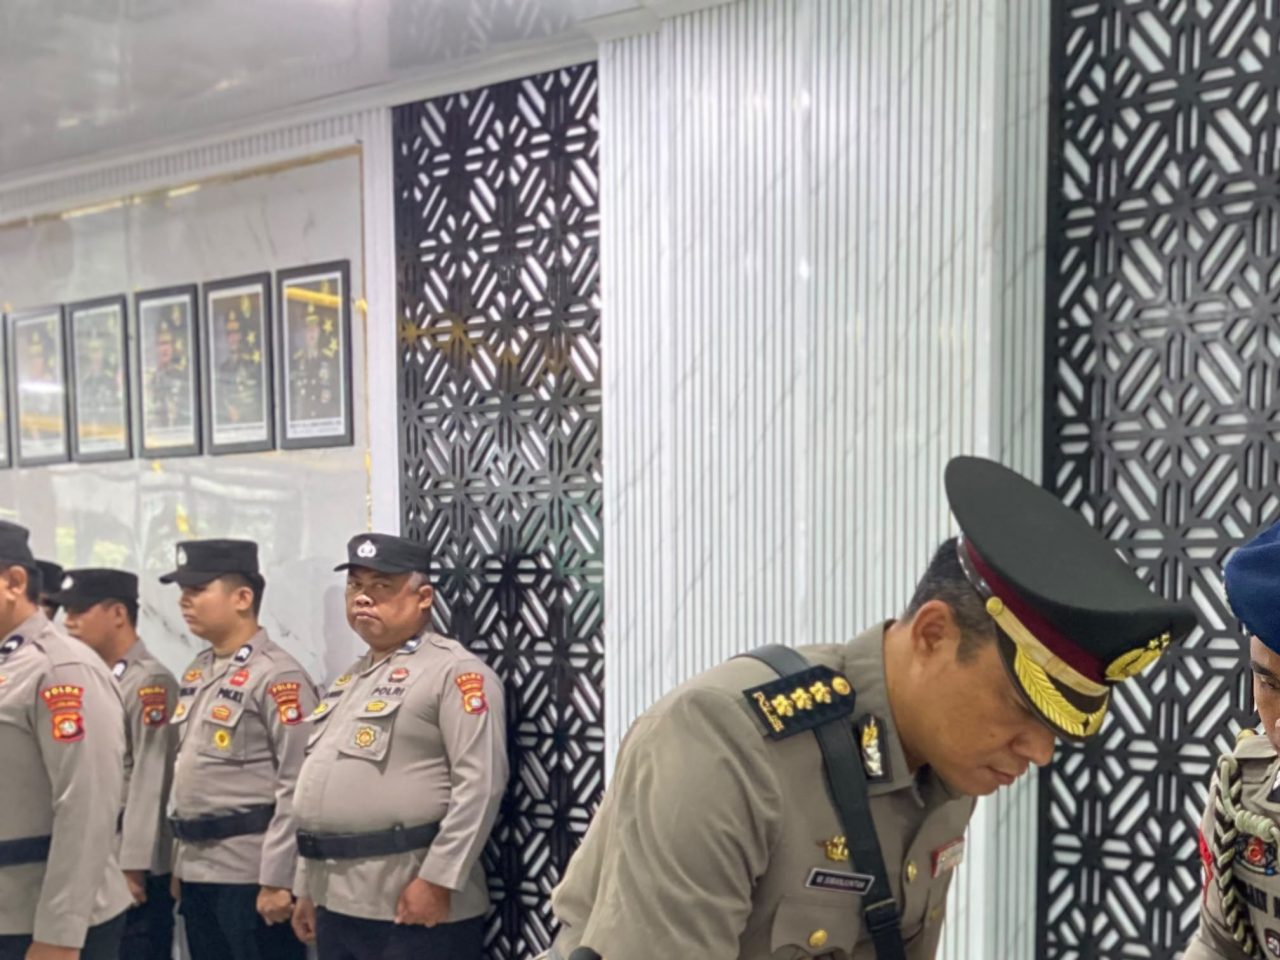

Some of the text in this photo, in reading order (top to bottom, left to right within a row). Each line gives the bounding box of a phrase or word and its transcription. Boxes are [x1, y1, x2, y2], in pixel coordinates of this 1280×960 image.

[44, 686, 79, 699] POLDA
[217, 688, 243, 703] POLRI
[371, 686, 406, 696] POLRI
